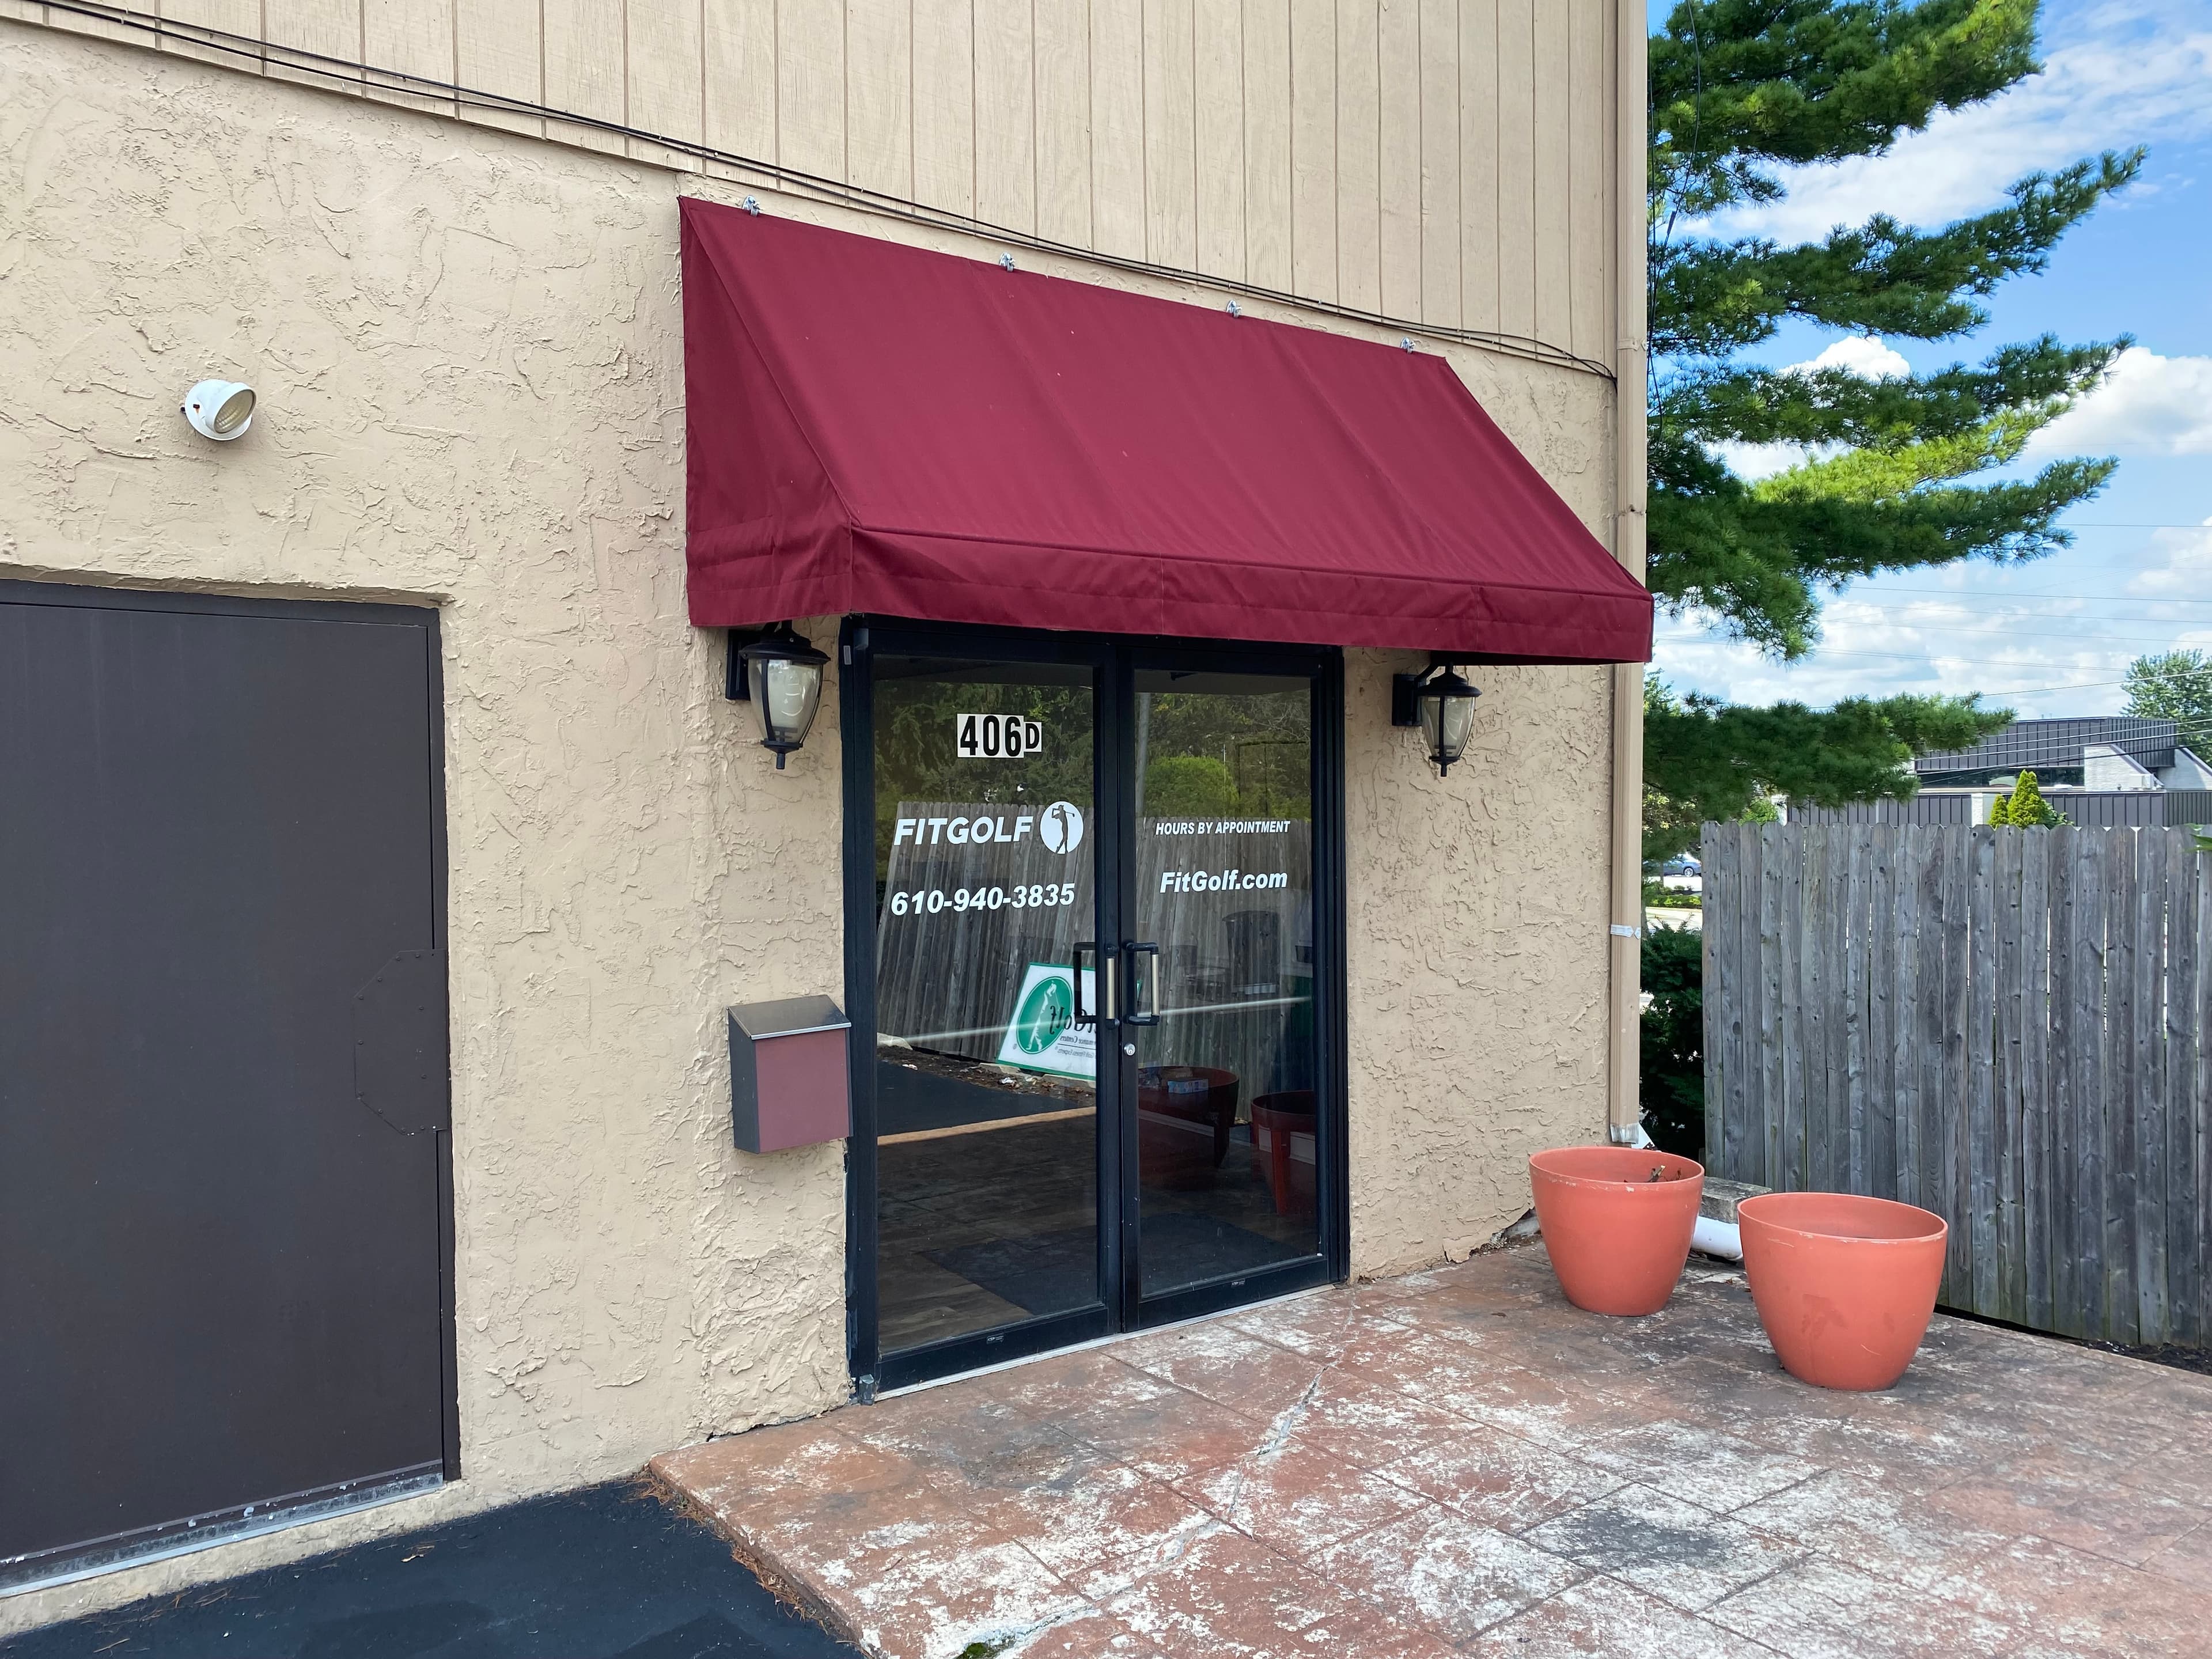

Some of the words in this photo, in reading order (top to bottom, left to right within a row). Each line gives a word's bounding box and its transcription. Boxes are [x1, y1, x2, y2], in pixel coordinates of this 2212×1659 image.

[960, 715, 1040, 757] 406D
[893, 816, 1034, 846] FITGOLF
[1156, 822, 1195, 835] HOURS
[1197, 821, 1213, 834] BY
[1214, 820, 1291, 834] APPOINTMENT
[1160, 869, 1288, 893] FitGolf.com
[891, 883, 1075, 915] 610-940-3835
